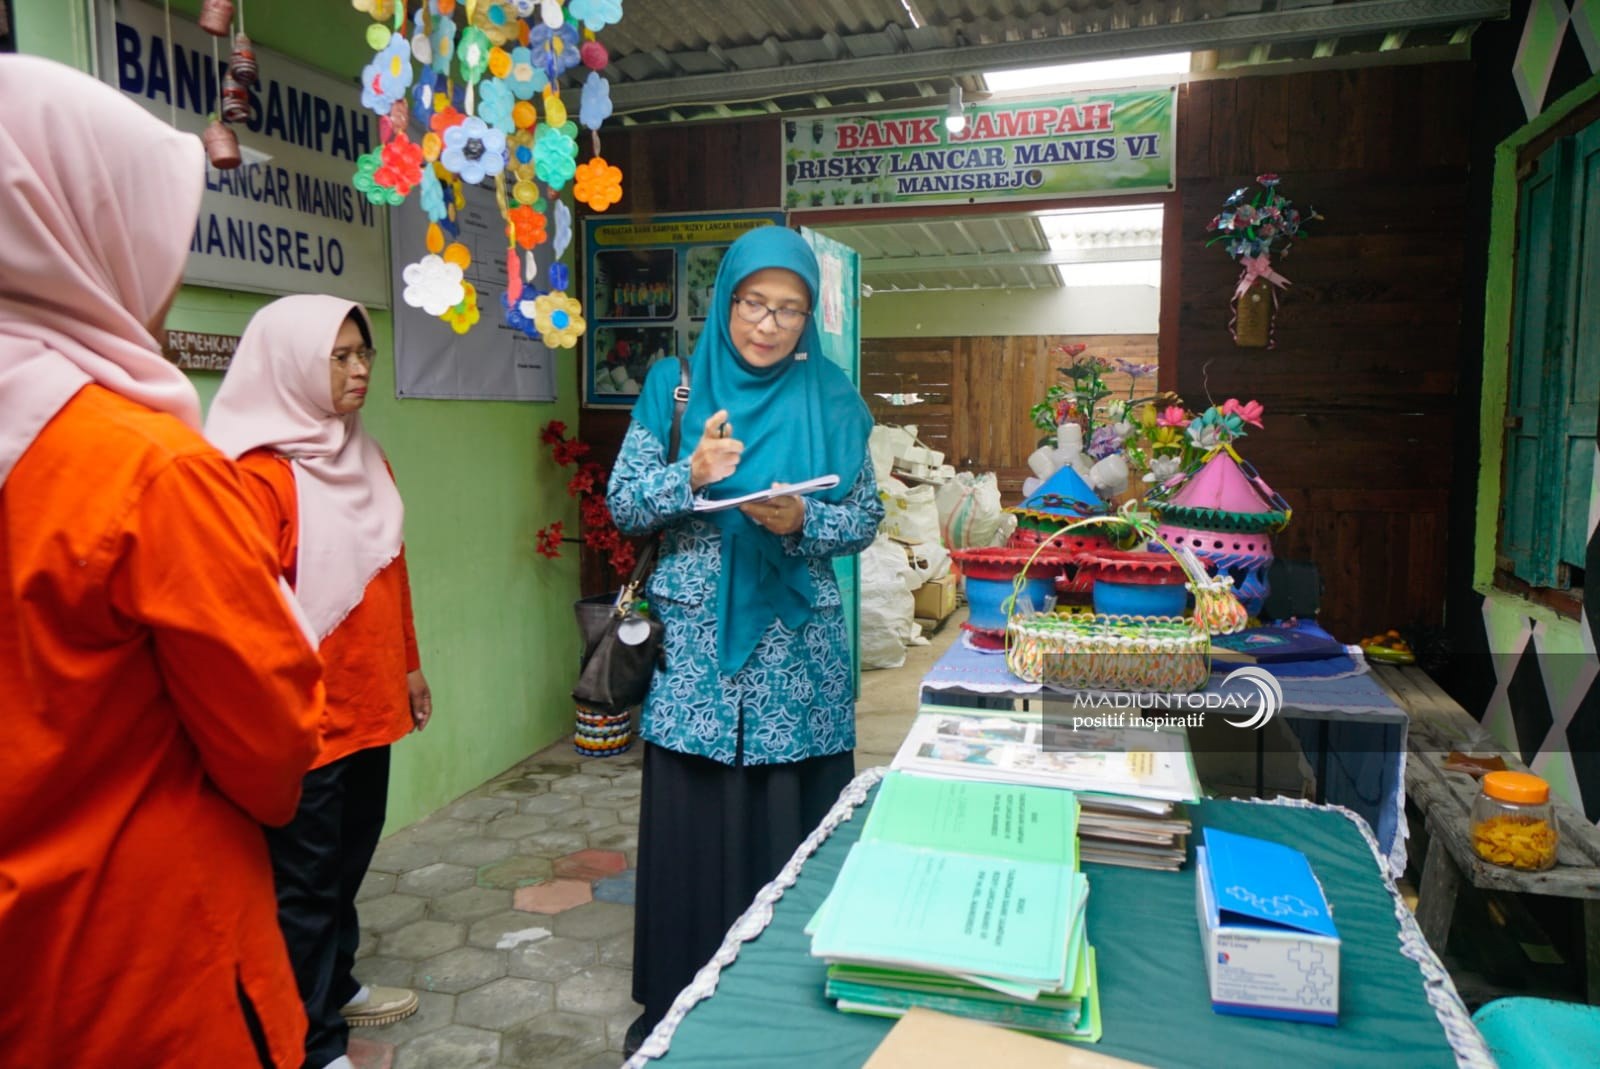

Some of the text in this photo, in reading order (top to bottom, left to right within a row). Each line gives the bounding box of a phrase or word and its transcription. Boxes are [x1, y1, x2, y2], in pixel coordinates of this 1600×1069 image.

[115, 22, 371, 163] BANK SAMPAH
[837, 103, 1114, 150] BANK SAMPAH
[797, 134, 1159, 179] RISKY LANCAR MANIS VI
[206, 162, 292, 209] LANCAR
[296, 172, 354, 223] MANIS
[897, 168, 1043, 194] MANISREJO
